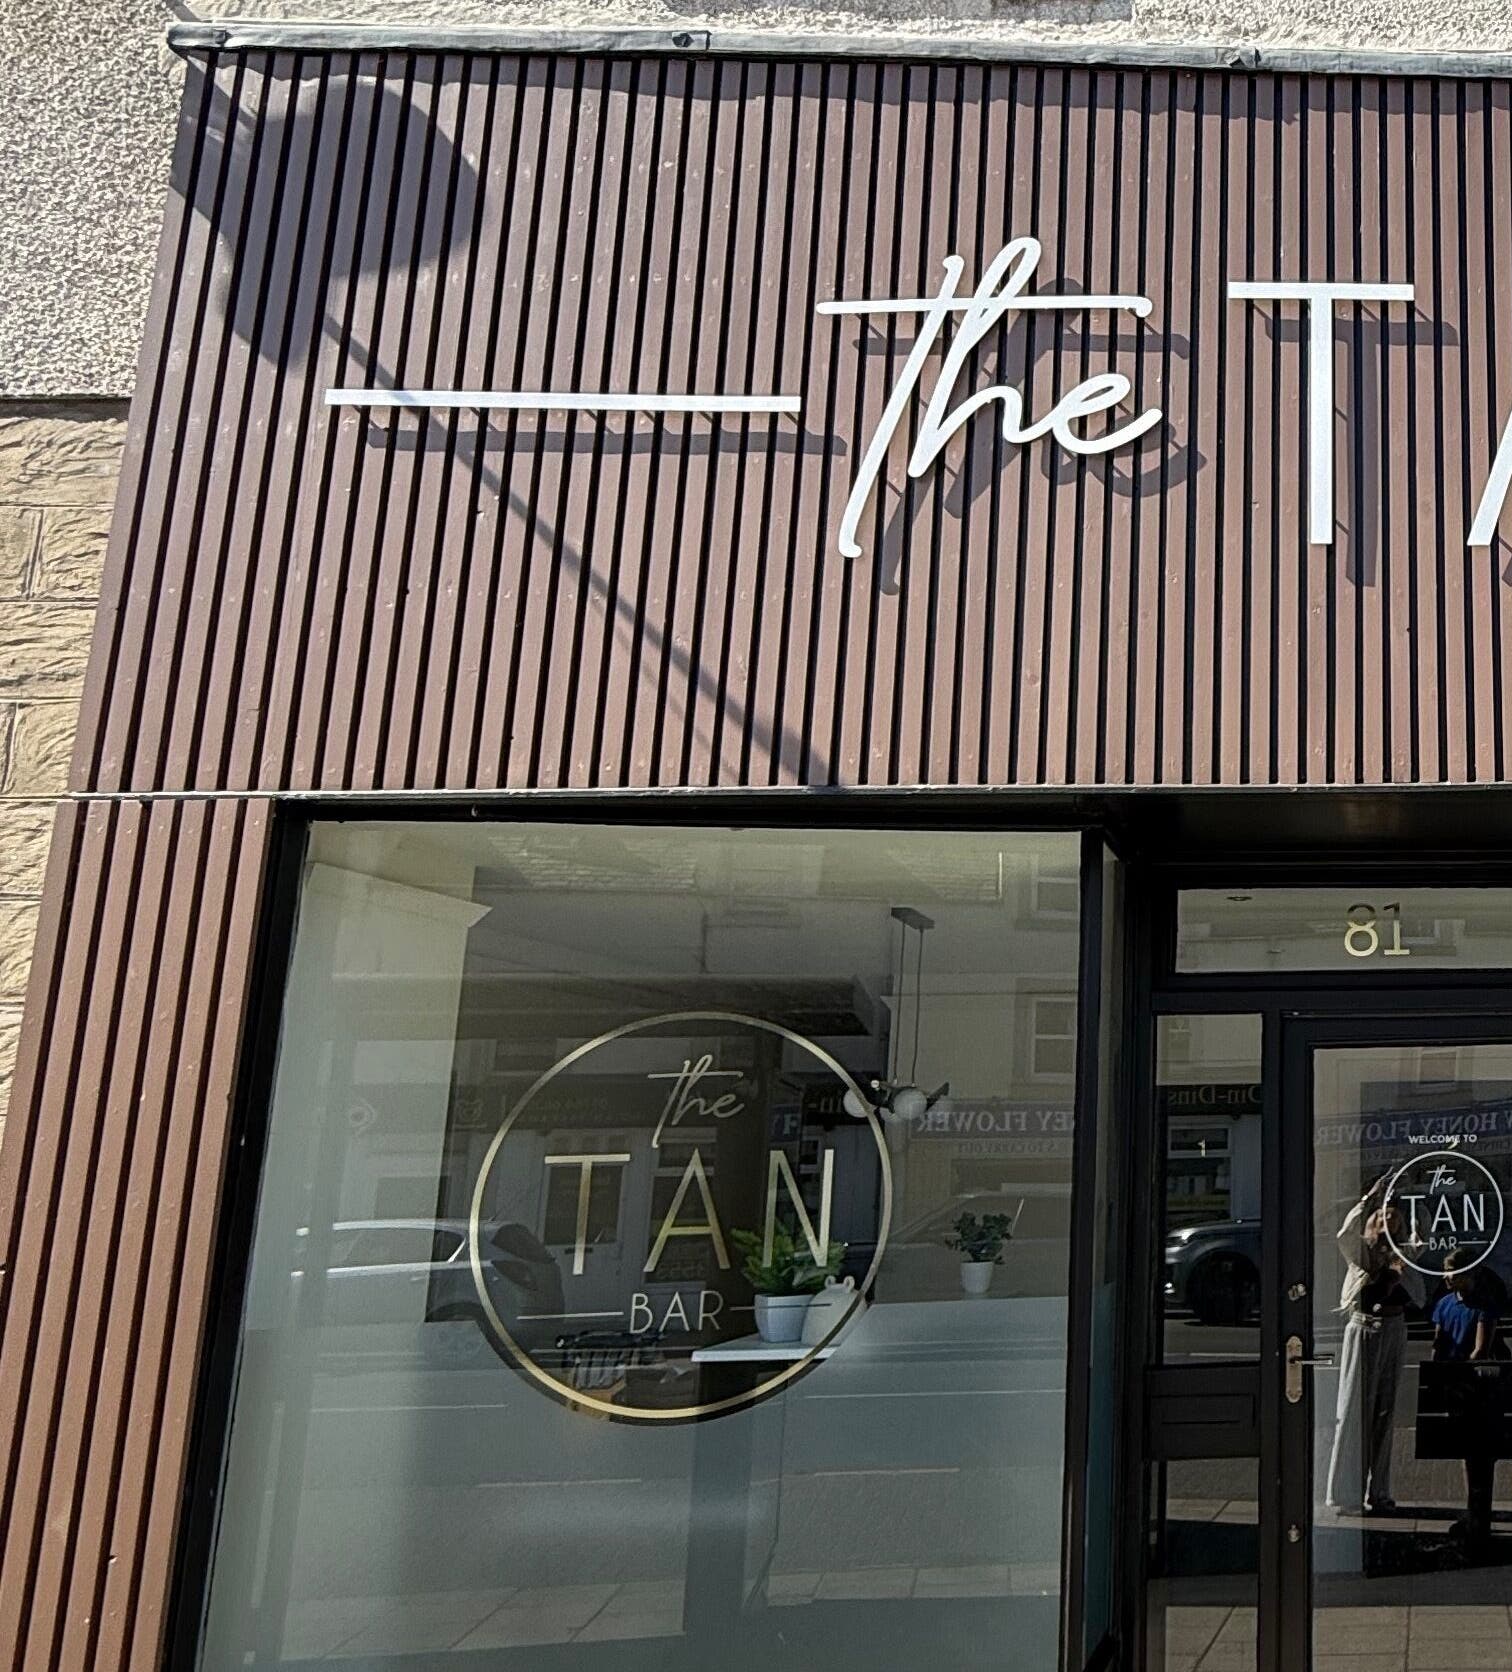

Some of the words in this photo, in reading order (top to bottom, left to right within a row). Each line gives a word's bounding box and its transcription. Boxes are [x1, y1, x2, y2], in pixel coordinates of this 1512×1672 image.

[816, 235, 1163, 559] the
[1343, 902, 1411, 957] 81
[647, 1055, 745, 1148] the
[1408, 1135, 1461, 1145] WELCOME
[1464, 1134, 1478, 1143] TO
[1426, 1164, 1456, 1194] the
[544, 1147, 837, 1276] TAN
[1400, 1194, 1485, 1233] TAN
[1429, 1236, 1457, 1250] BAR
[628, 1290, 724, 1334] BAR
